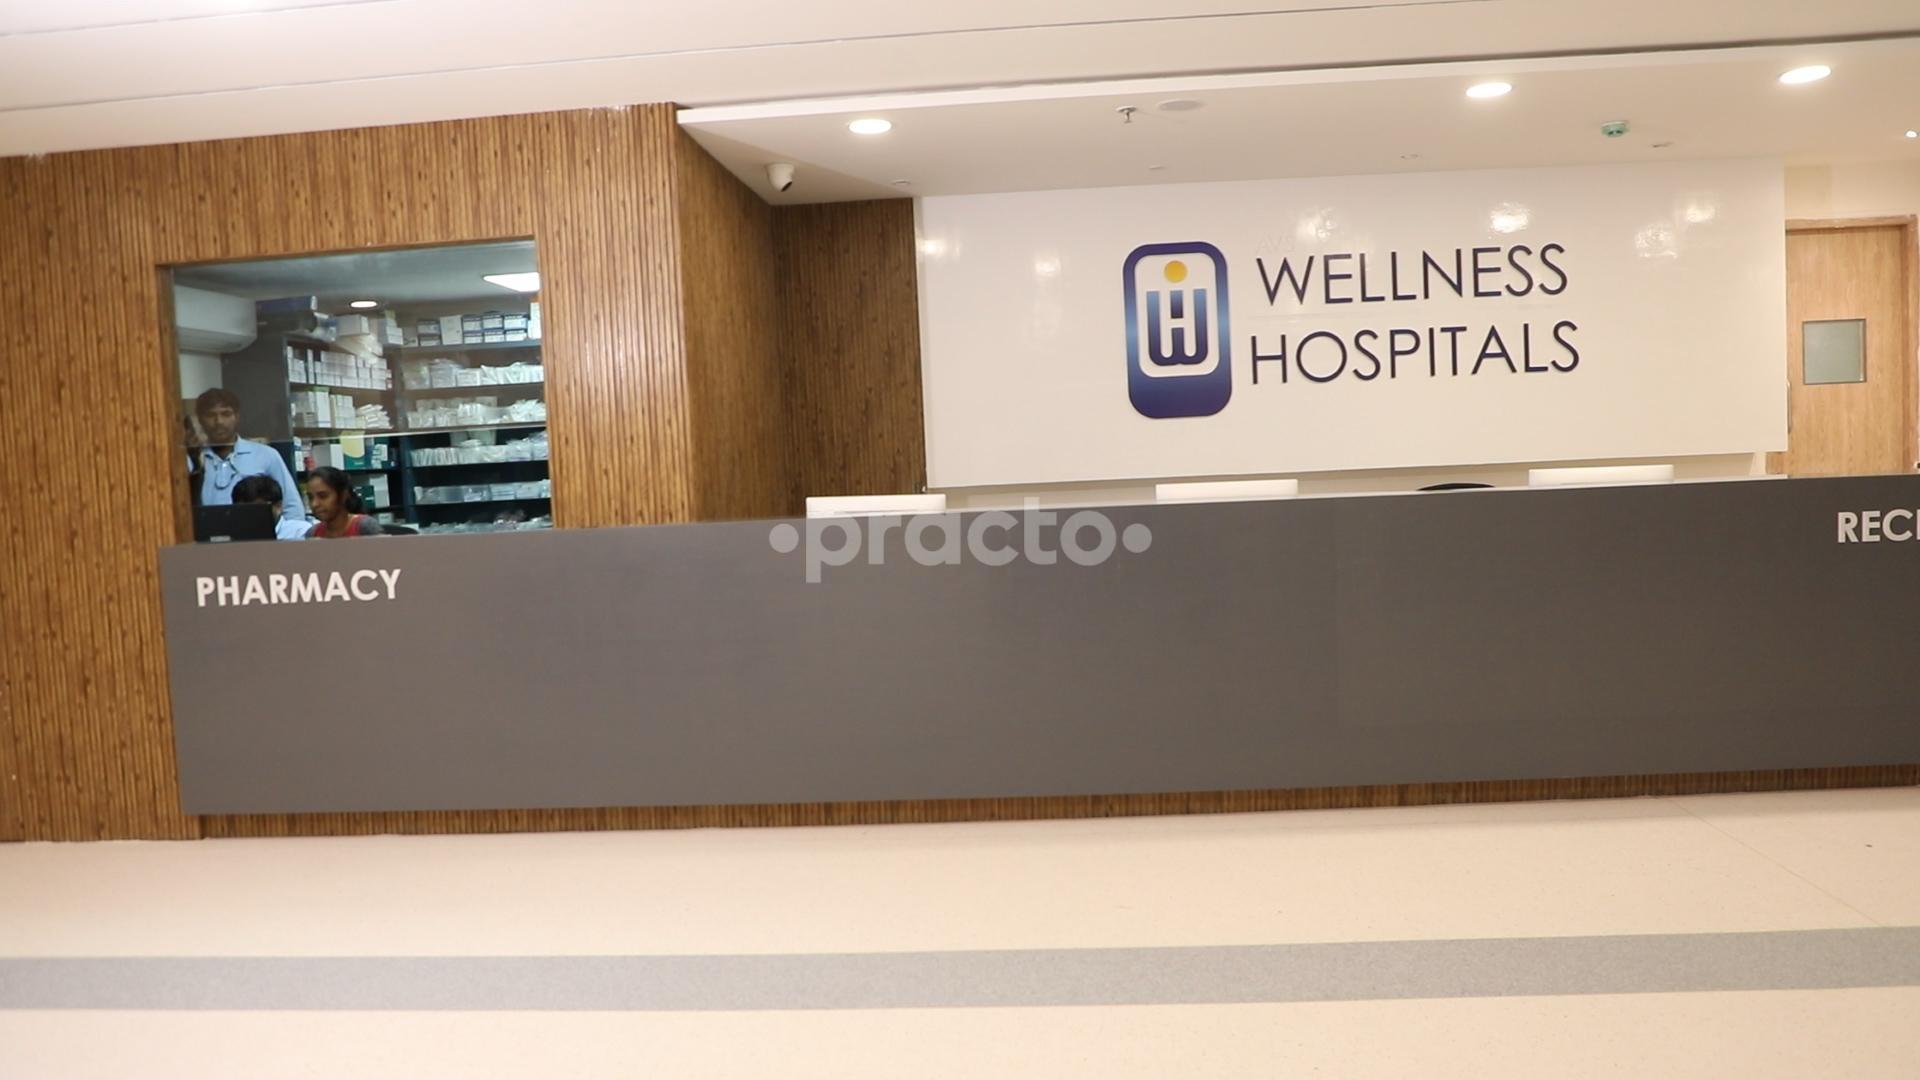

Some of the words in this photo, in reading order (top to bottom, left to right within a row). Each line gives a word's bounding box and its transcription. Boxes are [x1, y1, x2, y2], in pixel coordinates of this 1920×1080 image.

[1256, 243, 1568, 306] WELLNESS
[1250, 320, 1580, 385] HOSPITALS
[1837, 508, 1920, 543] REC
[196, 568, 401, 607] PHARMACY
